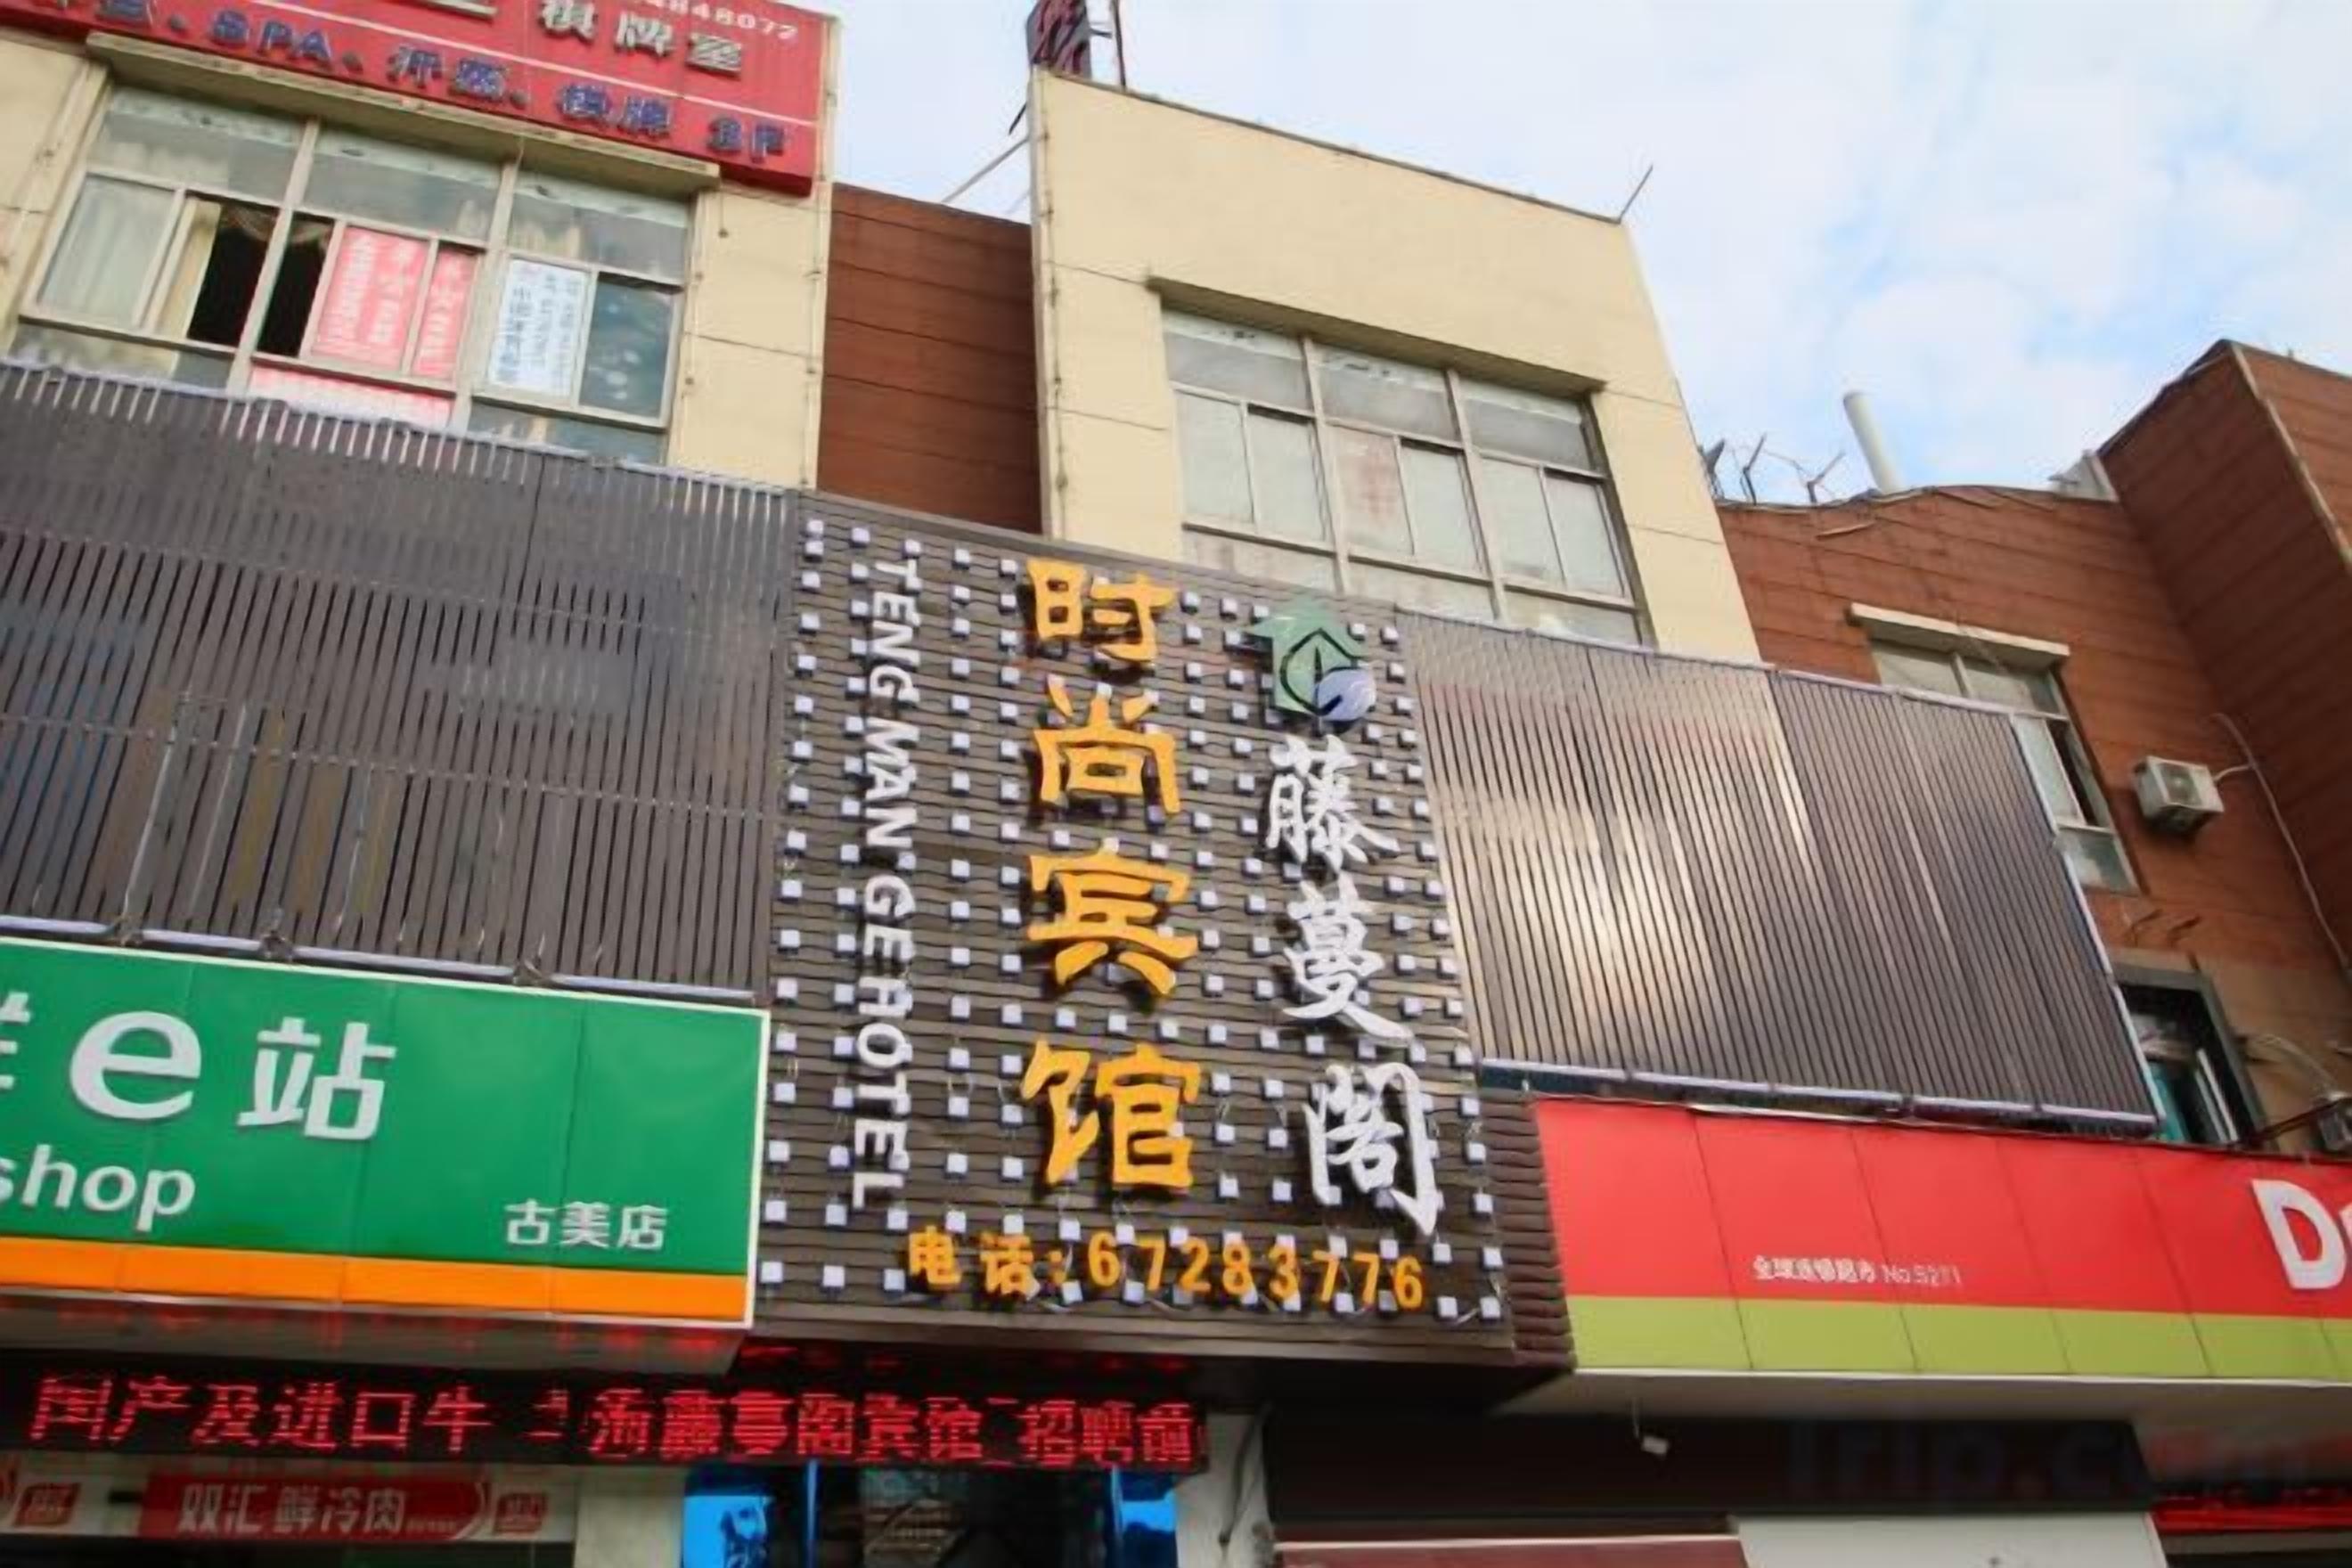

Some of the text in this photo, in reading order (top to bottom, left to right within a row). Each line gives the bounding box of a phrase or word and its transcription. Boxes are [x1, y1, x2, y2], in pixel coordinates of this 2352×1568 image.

[868, 559, 921, 701] TENG
[864, 716, 920, 848] MAN
[1020, 556, 1202, 1189] 时尚宾馆
[1265, 733, 1440, 1236] 藤蔓阁
[852, 976, 913, 1210] HOTEL
[503, 1198, 669, 1251] 古美店
[2250, 1179, 2352, 1290] D
